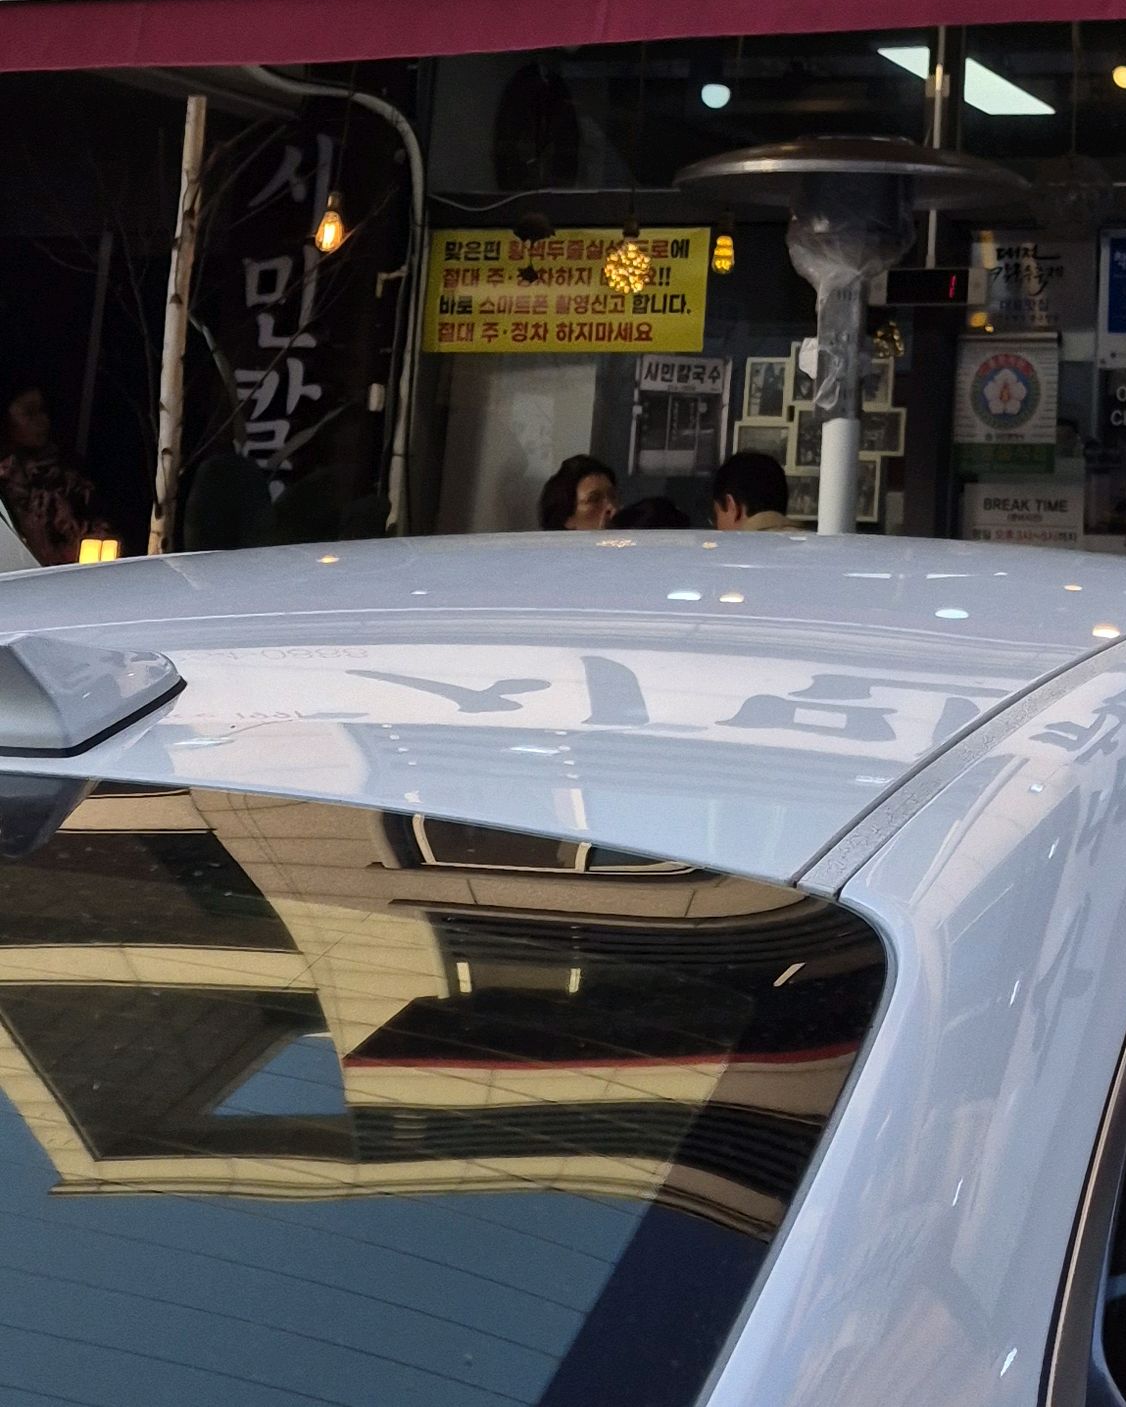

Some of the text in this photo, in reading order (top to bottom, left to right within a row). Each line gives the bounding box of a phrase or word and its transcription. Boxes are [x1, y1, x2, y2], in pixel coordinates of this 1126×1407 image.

[442, 266, 480, 288] 절대
[439, 294, 473, 315] 바로
[478, 294, 549, 315] 스마트폰
[632, 293, 692, 315] 합니다.
[437, 322, 475, 343] 절대
[644, 362, 721, 385] 시민칼국수
[984, 497, 1069, 513] BREAK TIME
